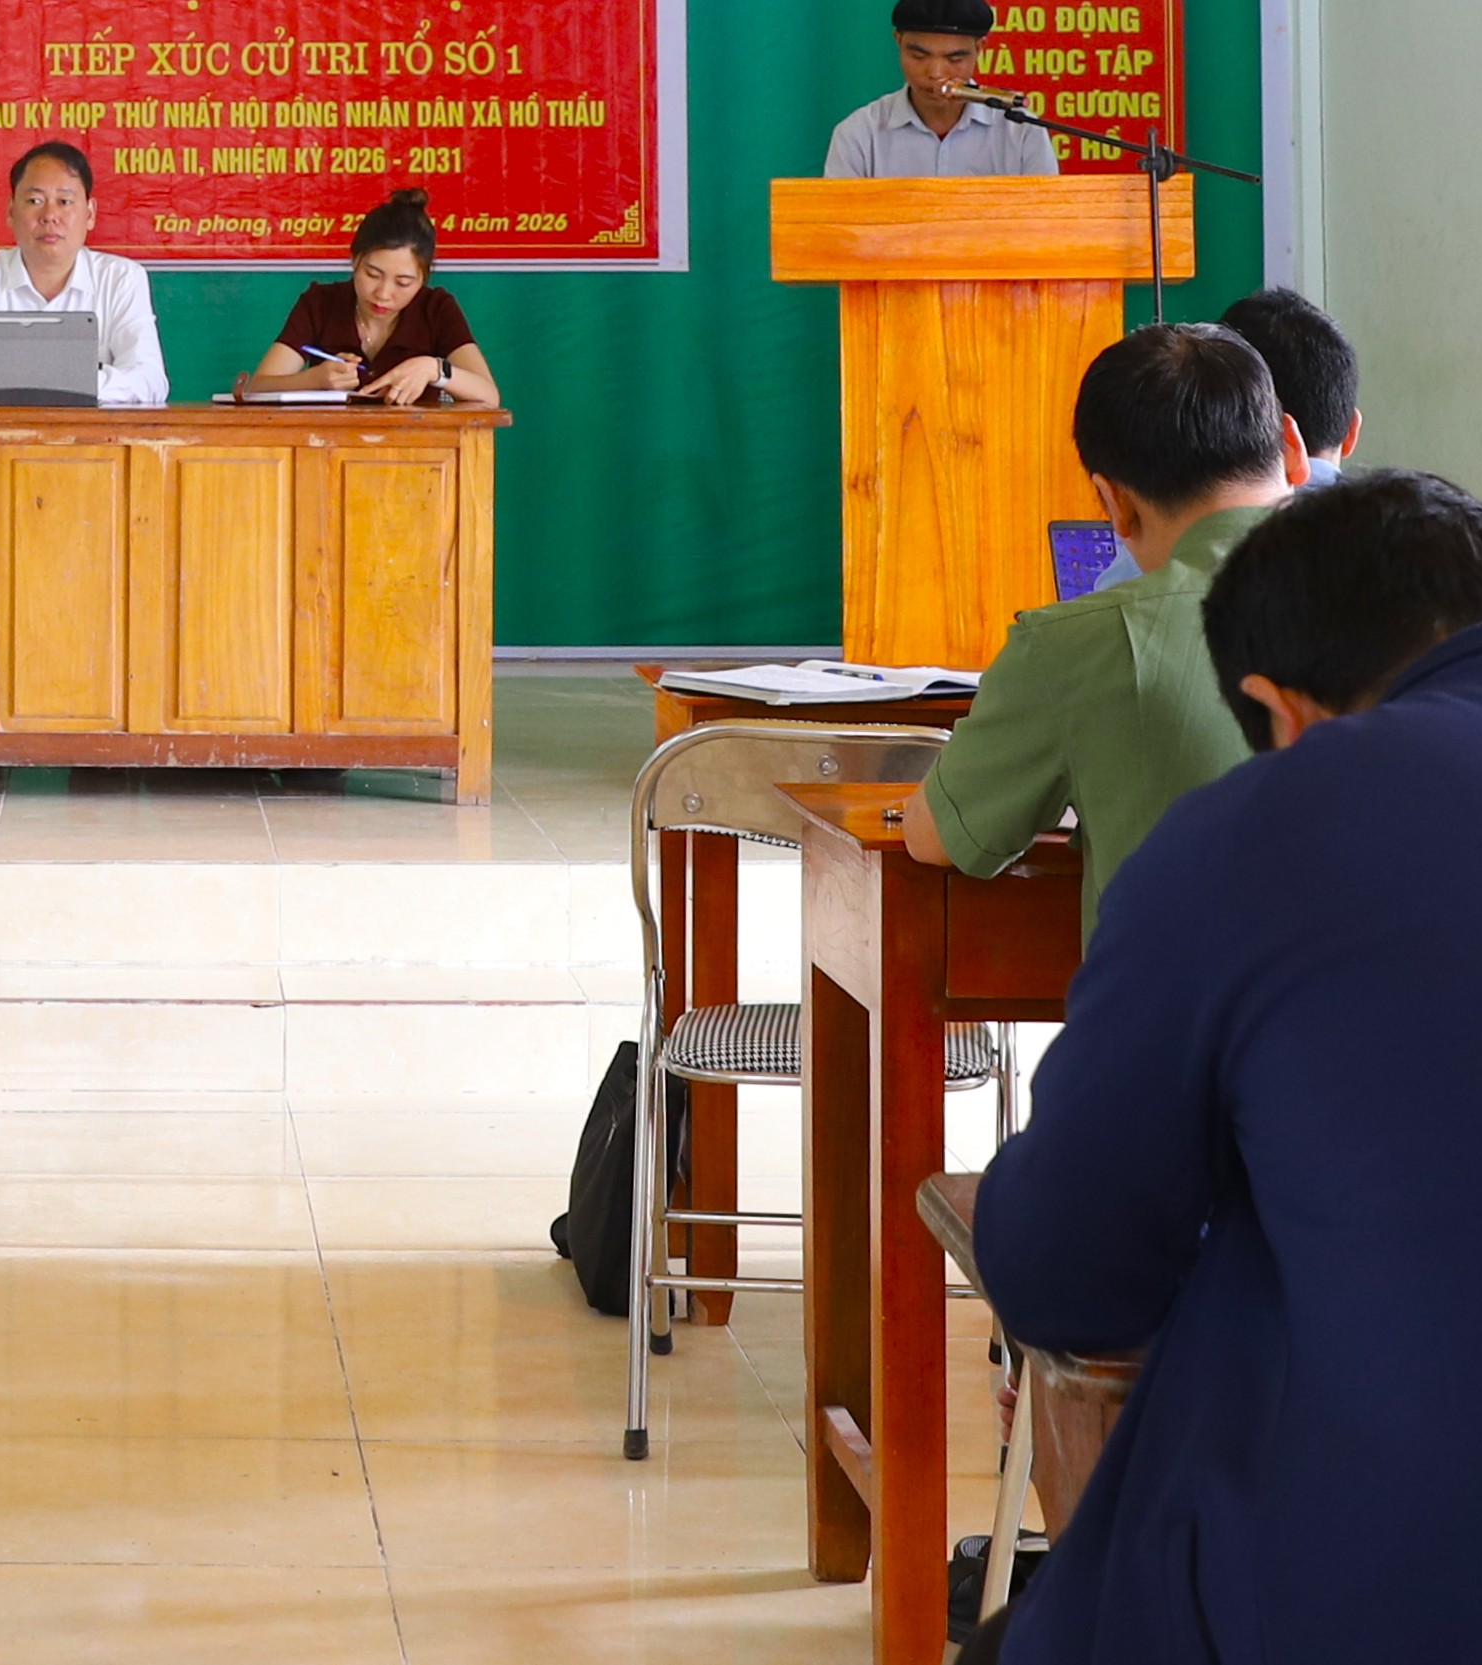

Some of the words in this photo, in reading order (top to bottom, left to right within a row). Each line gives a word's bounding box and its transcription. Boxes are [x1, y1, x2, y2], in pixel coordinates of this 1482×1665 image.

[991, 7, 1045, 32] LAO
[1055, 2, 1140, 38] ĐỘNG
[45, 23, 135, 78] TIẾP
[152, 28, 229, 78] XÚC
[240, 26, 295, 78] CỬ
[304, 41, 368, 76] TRI
[381, 19, 434, 78] TỔ
[443, 25, 495, 78] SỐ
[506, 42, 522, 76] 1
[976, 44, 1014, 74] VÀ
[1025, 49, 1085, 80] HỌC
[1096, 44, 1153, 80] TẬP
[23, 96, 56, 130] KỲ
[60, 101, 108, 136] HỌP
[113, 97, 159, 128] THỨ
[163, 96, 223, 128] NHẤT
[229, 96, 270, 136] HỘI
[275, 94, 338, 128] ĐỒNG
[345, 96, 413, 130] NHÂN
[417, 96, 466, 130] DÂN
[471, 96, 504, 130] XÃ
[509, 93, 541, 130] HỒ
[1056, 90, 1160, 117] GƯƠNG
[114, 141, 178, 176] KHÓA
[182, 147, 205, 180] II,
[211, 142, 290, 181] NHIỆM
[294, 142, 327, 176] KỲ
[331, 147, 386, 173] 2026
[409, 147, 460, 173] 2031
[154, 212, 191, 234] Tân
[195, 213, 274, 238] phong,
[281, 214, 334, 237] ngày
[441, 212, 456, 234] 4
[461, 212, 509, 234] năm
[514, 212, 568, 234] 2026
